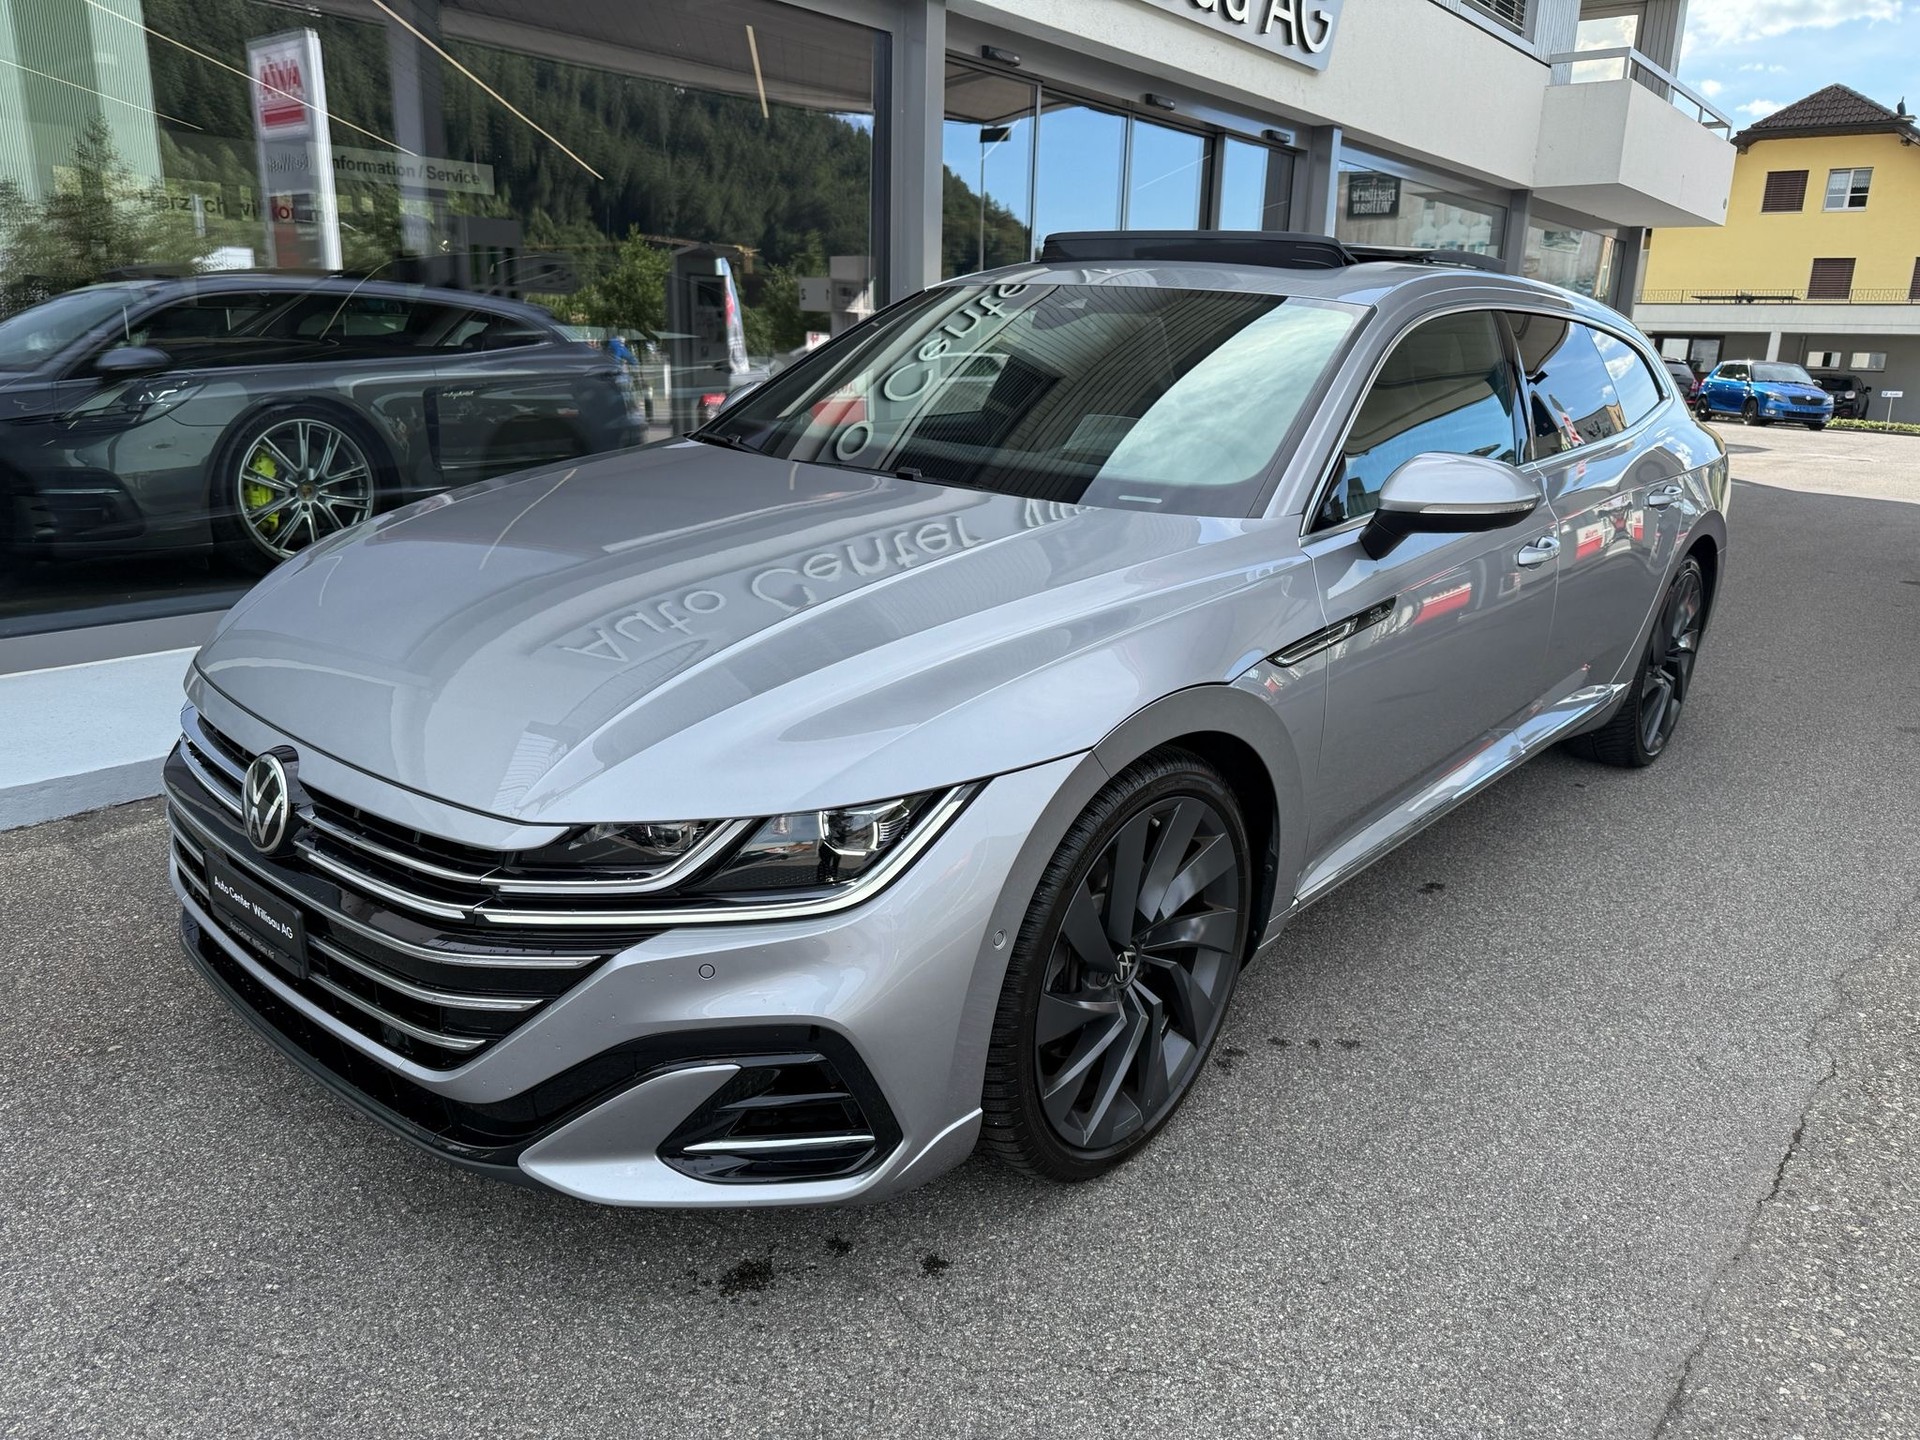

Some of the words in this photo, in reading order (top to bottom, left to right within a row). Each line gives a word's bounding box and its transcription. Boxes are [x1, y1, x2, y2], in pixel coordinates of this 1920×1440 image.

[1262, 0, 1334, 53] AG
[426, 164, 480, 185] Service
[214, 875, 229, 895] Auto
[229, 886, 251, 910] Center
[252, 902, 281, 931] Willisau
[281, 923, 294, 940] AG
